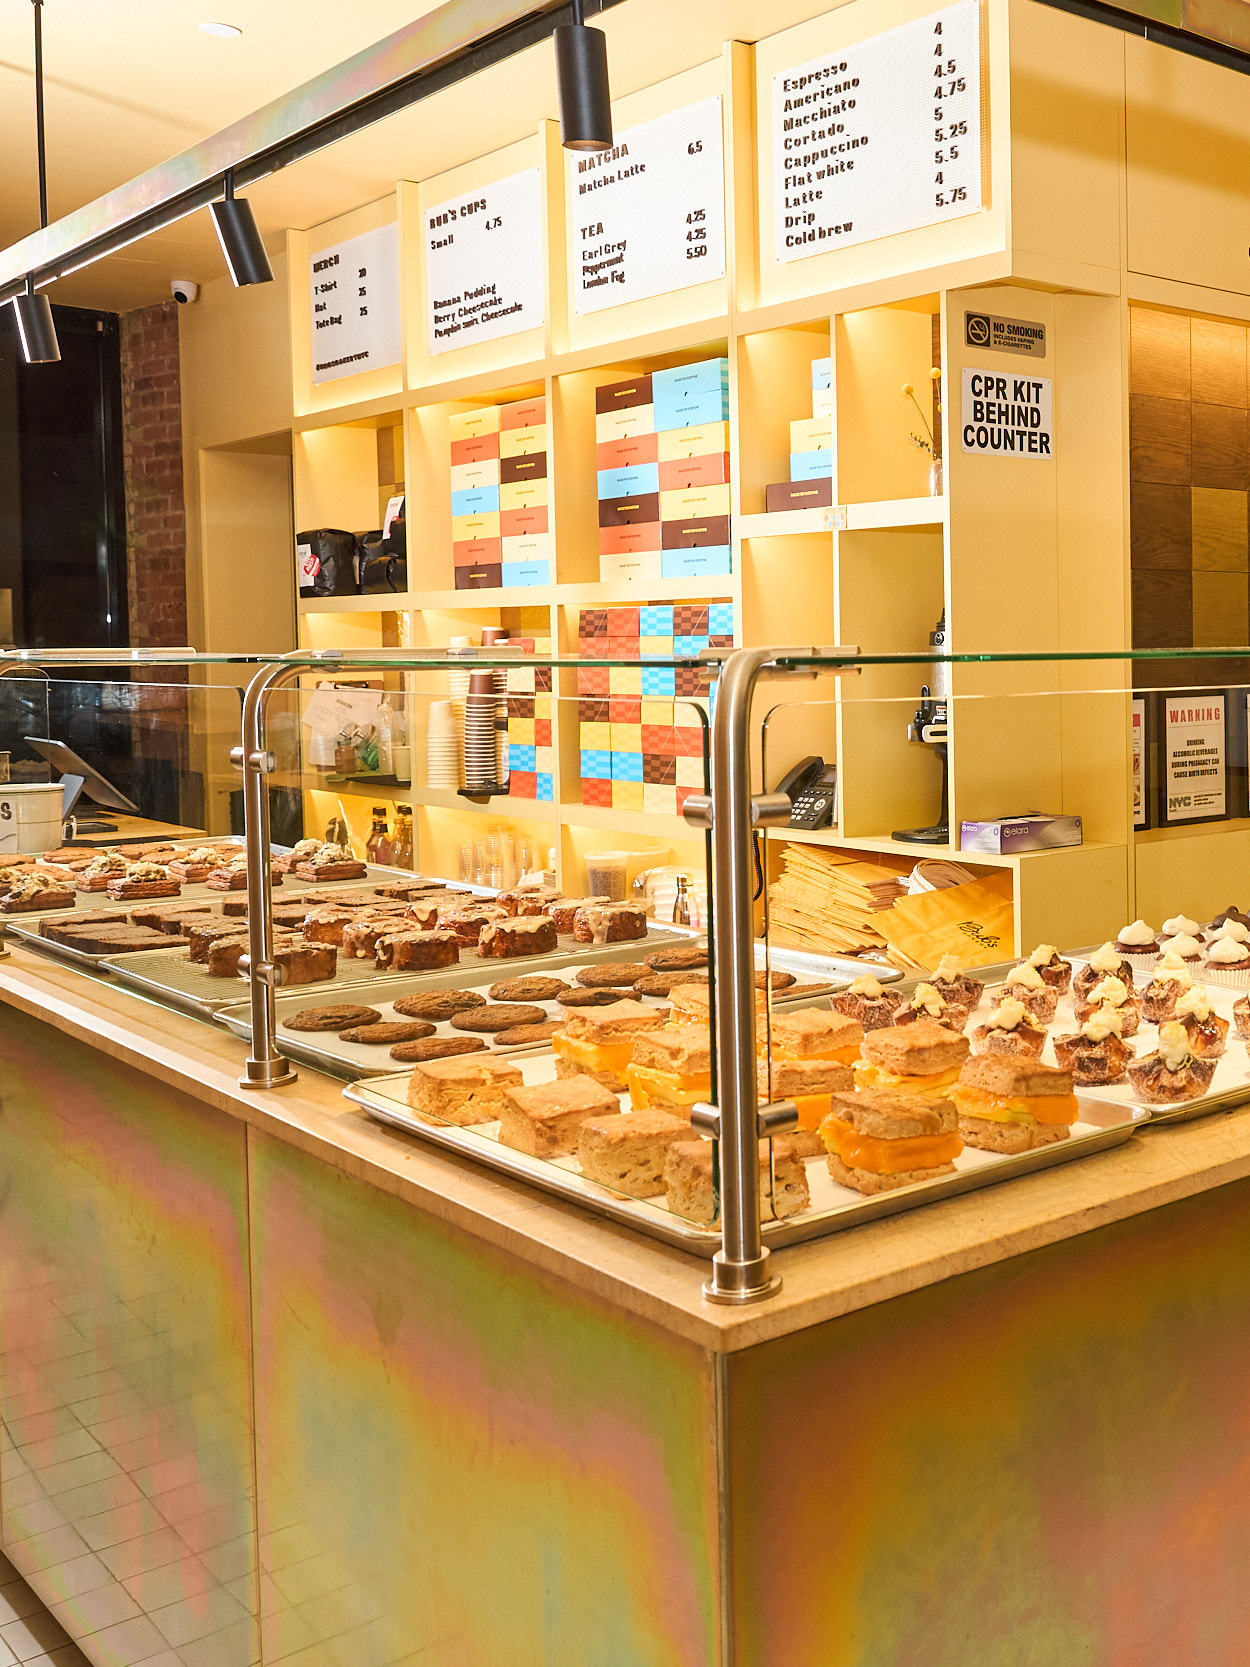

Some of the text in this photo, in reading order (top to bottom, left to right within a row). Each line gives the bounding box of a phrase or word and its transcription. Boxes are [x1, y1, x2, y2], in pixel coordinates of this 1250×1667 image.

[934, 21, 942, 35] 4
[934, 43, 942, 56] 4
[783, 62, 847, 91] Espresso
[934, 59, 956, 78] 4.5
[784, 78, 859, 112] Americano
[934, 78, 966, 99] 4.75
[783, 98, 856, 131] Macchiato
[934, 107, 943, 121] 5
[784, 123, 844, 150] Cortado
[934, 120, 968, 142] 5.25
[688, 140, 702, 154] 6.5
[784, 134, 868, 170] Cappuccino
[934, 146, 959, 164] 5.5
[578, 144, 628, 173] MATCHA
[579, 164, 645, 195] Matcha Latte
[784, 160, 854, 189] Flat white
[935, 172, 944, 184] 4
[785, 189, 823, 208] Latte
[935, 187, 967, 207] 5.75
[430, 199, 486, 229] BUB'S CUPS
[486, 216, 502, 230] 4.75
[686, 209, 705, 224] 4.25
[785, 211, 815, 228] Drip
[581, 222, 603, 239] TEA
[686, 228, 706, 241] 4.25
[786, 220, 853, 247] Cold brew
[431, 234, 453, 250] Small
[583, 240, 626, 261] Earl Grey
[687, 245, 707, 259] 5.50
[314, 254, 339, 273] MERCH
[314, 281, 337, 295] T-Shirt
[434, 284, 496, 309] Banana Pudding
[434, 297, 502, 324] Berry Cheesecake
[435, 322, 461, 338] Pumpkin
[481, 302, 523, 322] Cheesecake
[316, 320, 329, 329] Tote
[994, 322, 1043, 339] NO SMOKING
[998, 341, 1031, 350] E-CIGARETTES
[971, 375, 1043, 404] CPR KIT
[974, 400, 1041, 428] BEHIND
[964, 425, 1050, 454] COUNTER
[1170, 708, 1220, 723] WARNING
[1169, 796, 1191, 808] NYC
[1012, 827, 1028, 835] elara
[956, 921, 1000, 947] Bub's
